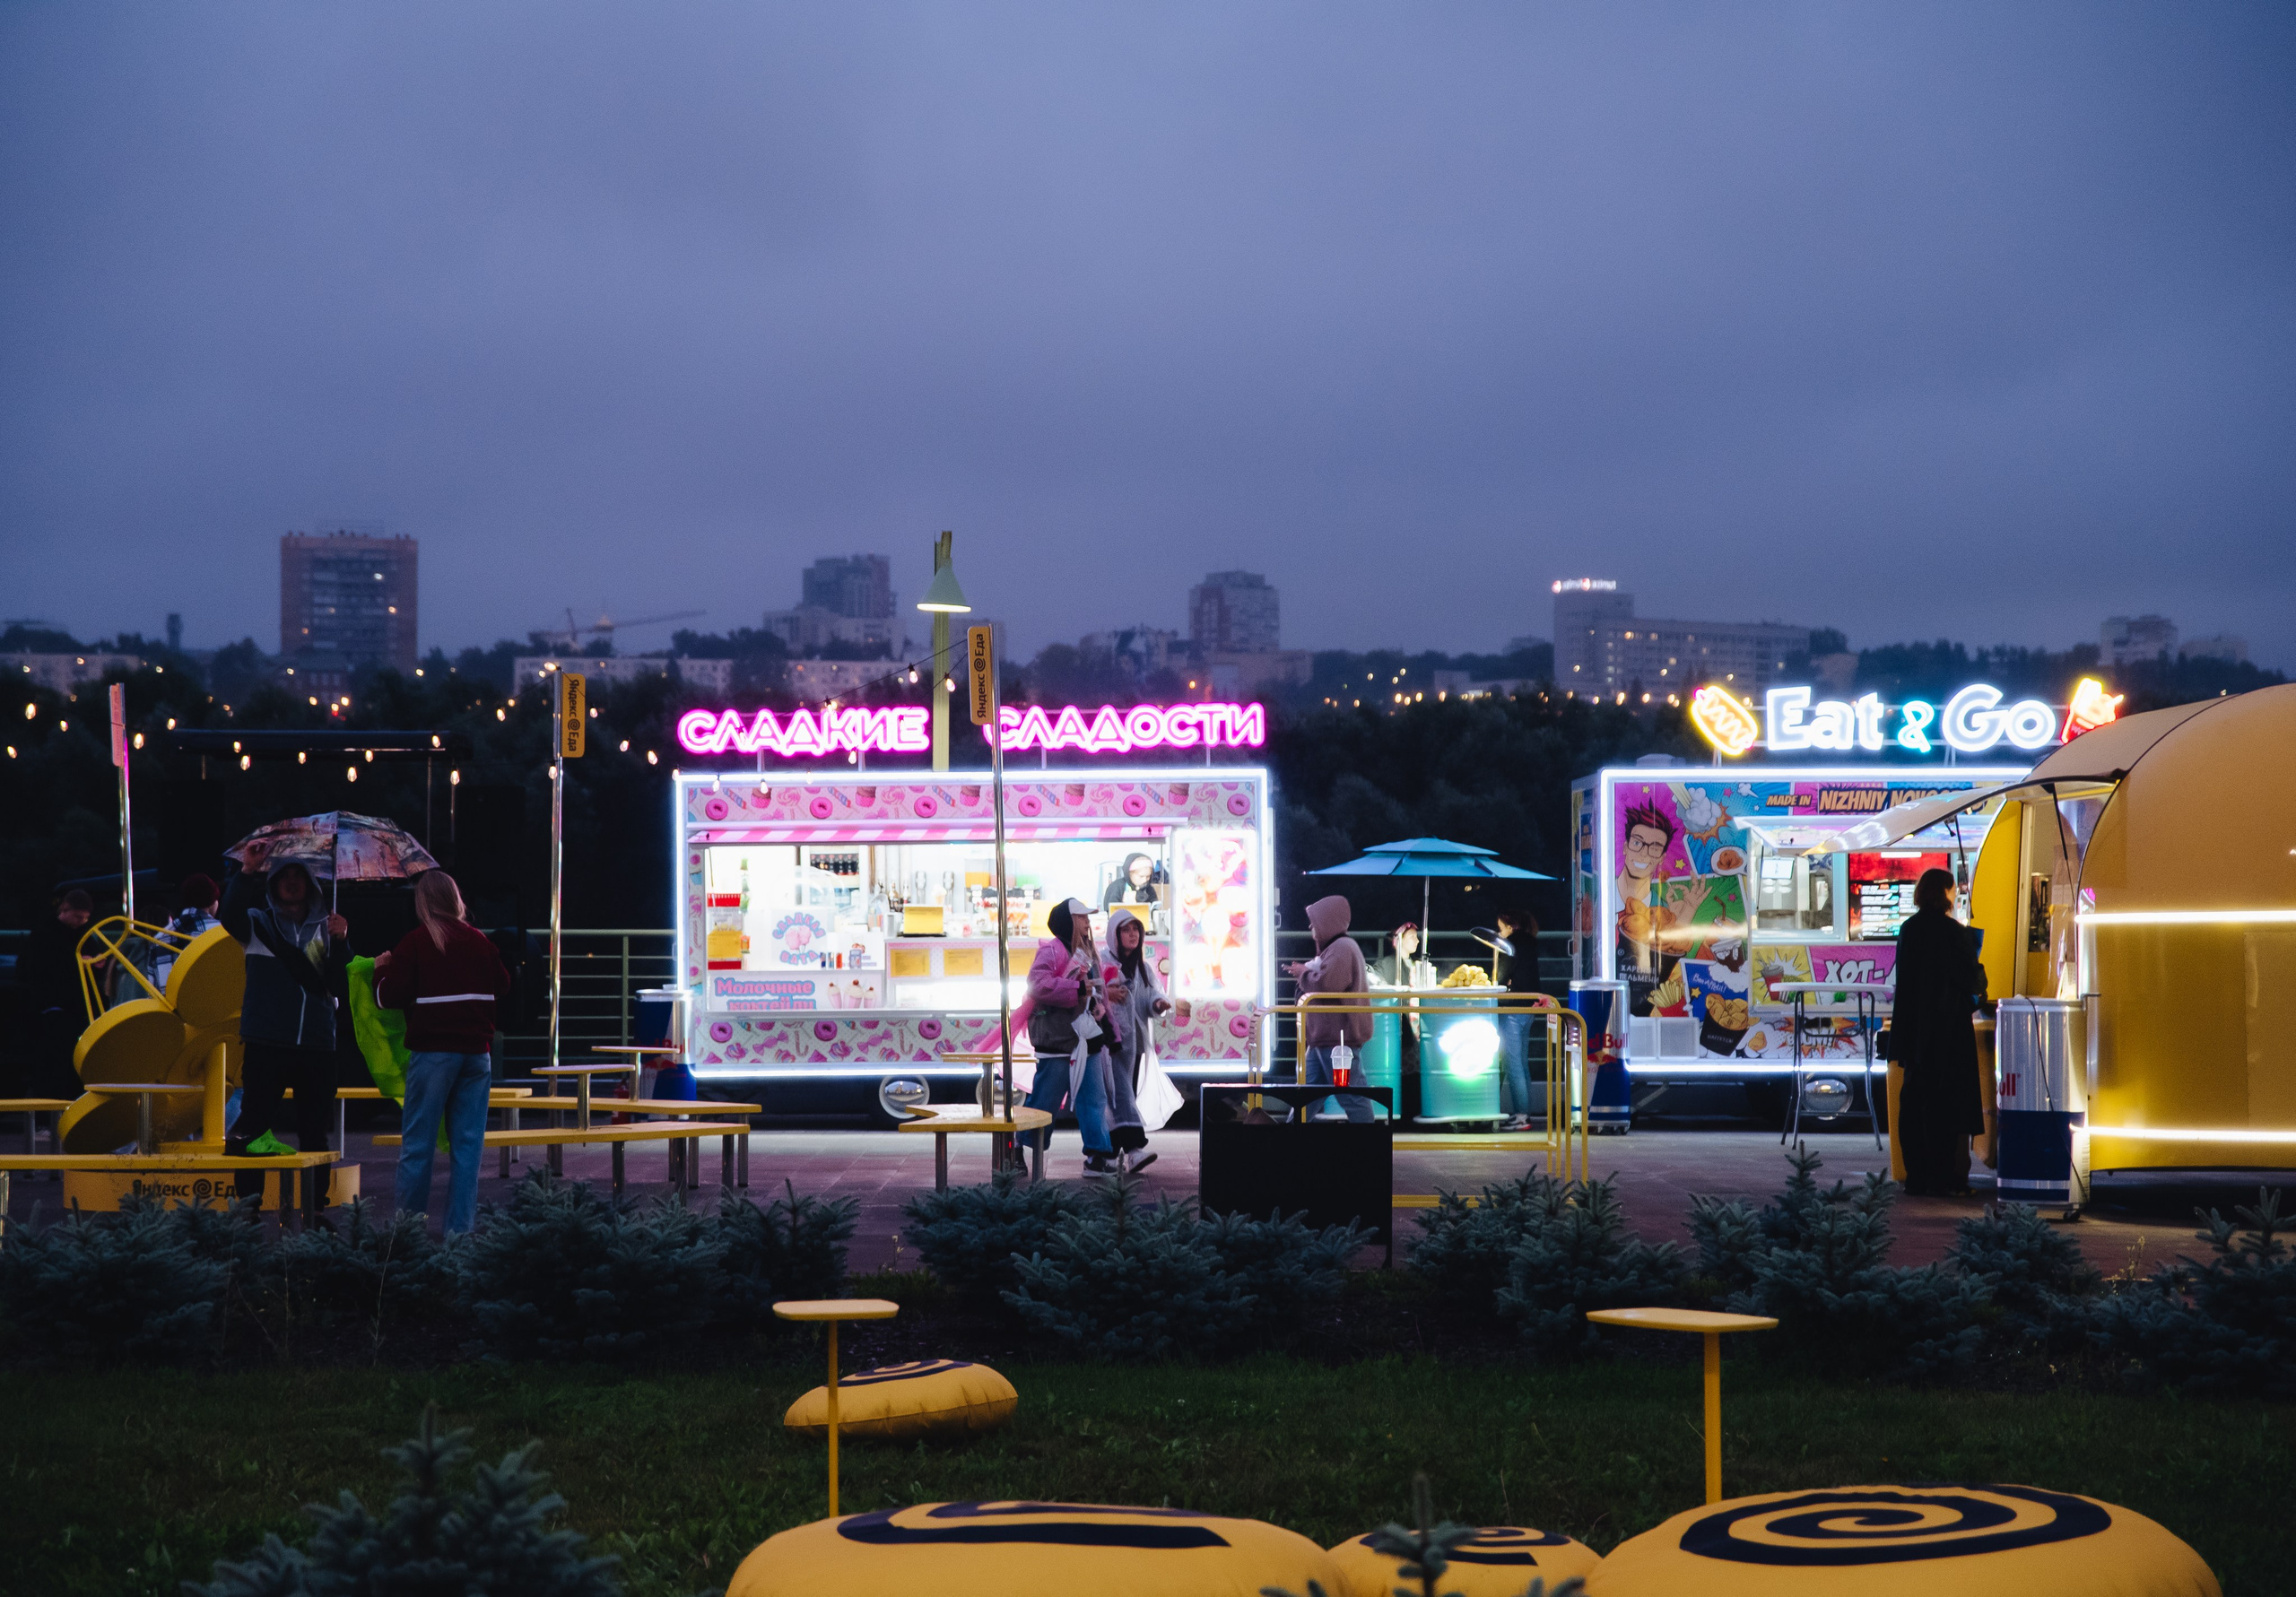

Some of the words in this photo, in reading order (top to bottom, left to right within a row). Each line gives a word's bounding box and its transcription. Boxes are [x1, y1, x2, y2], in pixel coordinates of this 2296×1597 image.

[975, 633, 985, 656] Еда
[568, 679, 579, 717] Яндекс
[977, 673, 987, 718] Яндекс
[678, 707, 930, 757] СЛАДКИЕ
[983, 702, 1265, 753] СЛАДОСТИ
[1766, 686, 1884, 751] Eat
[1897, 699, 1935, 753] &
[1942, 683, 2057, 752] Go
[568, 732, 579, 751] Еда
[1766, 795, 1797, 806] MADE
[1798, 794, 1812, 806] IN
[1819, 789, 1888, 812] NIZHNIY
[779, 950, 820, 966] ВАТА
[715, 977, 815, 996] Молочные
[1602, 1033, 1628, 1049] Bull
